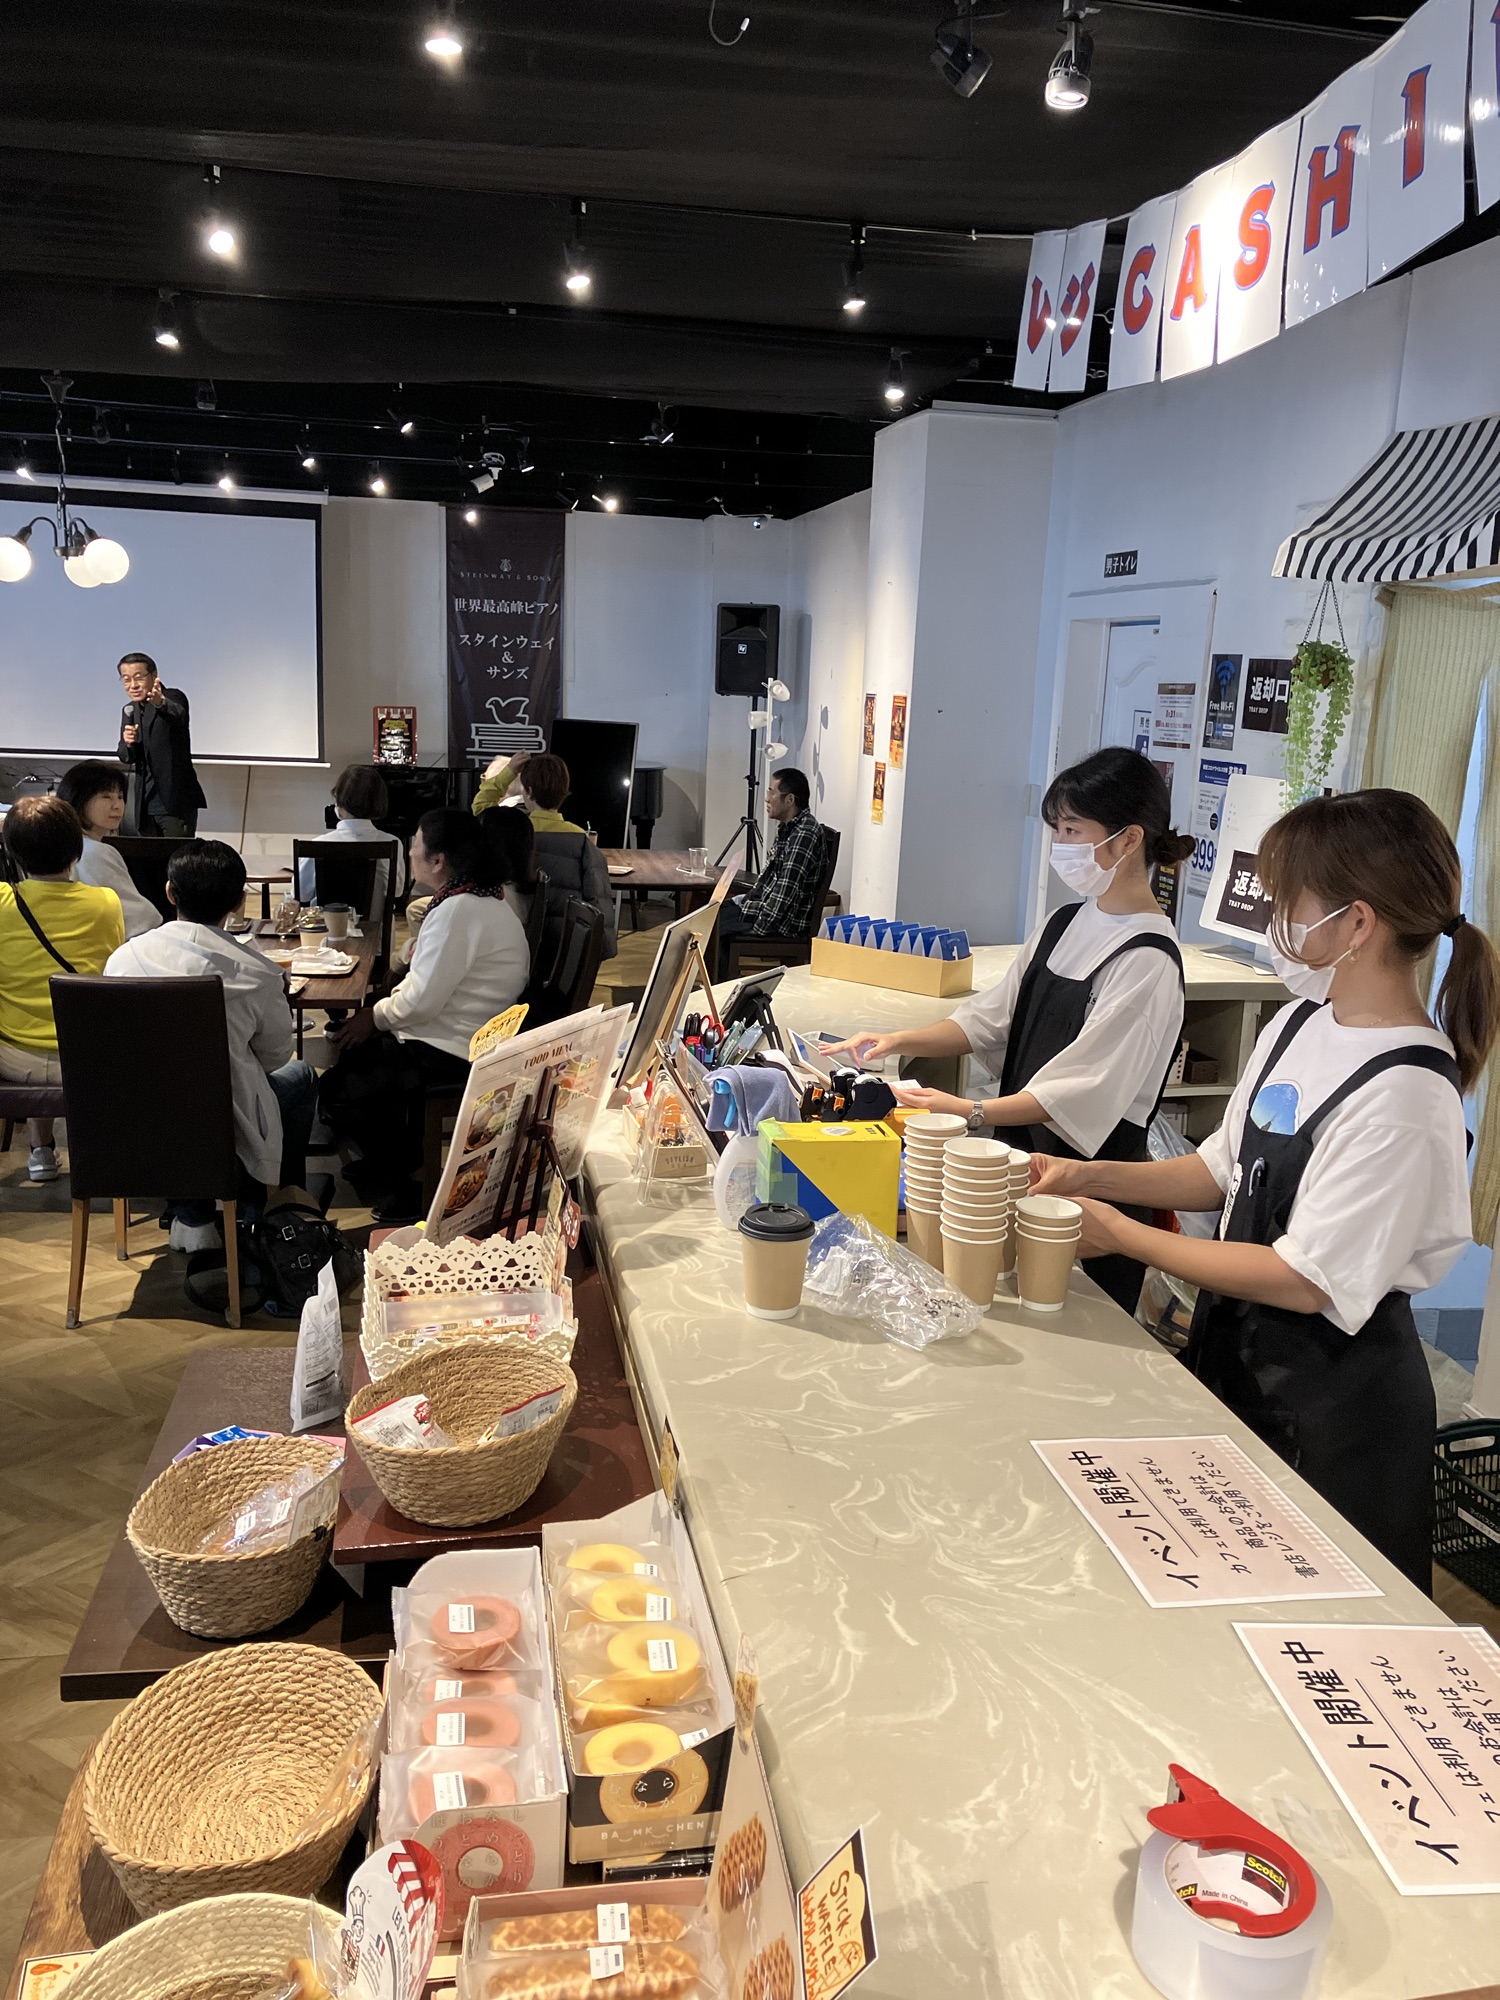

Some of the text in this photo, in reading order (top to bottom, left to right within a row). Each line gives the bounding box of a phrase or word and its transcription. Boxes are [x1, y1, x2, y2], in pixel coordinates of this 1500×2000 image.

[1122, 0, 1500, 335] CASHI
[460, 571, 511, 580] STEINWAY
[1105, 555, 1137, 574] 男子トイレ
[454, 597, 559, 616] 世界最高峰ピアノ
[459, 633, 556, 650] スタインウェイ
[501, 651, 515, 664] &
[486, 665, 530, 680] サンズ
[1250, 676, 1290, 703] 返却口
[1209, 700, 1234, 711] Free Wi-Fi
[1191, 837, 1217, 873] 99.9
[1228, 899, 1254, 912] TRAY DROP
[1068, 1450, 1200, 1589] イベント開催中
[1138, 1456, 1252, 1574] カフェは利用できません
[1189, 1475, 1269, 1549] 商品のお会計は
[1192, 1451, 1320, 1578] 書店レジをご利用ください
[1280, 1641, 1460, 1865] イベント開催中
[1246, 1856, 1286, 1889] Scotch
[829, 1869, 853, 1937] STICK
[1178, 1884, 1196, 1897] tch
[1201, 1889, 1249, 1907] Made in China
[817, 1893, 838, 1976] WAFFLE
